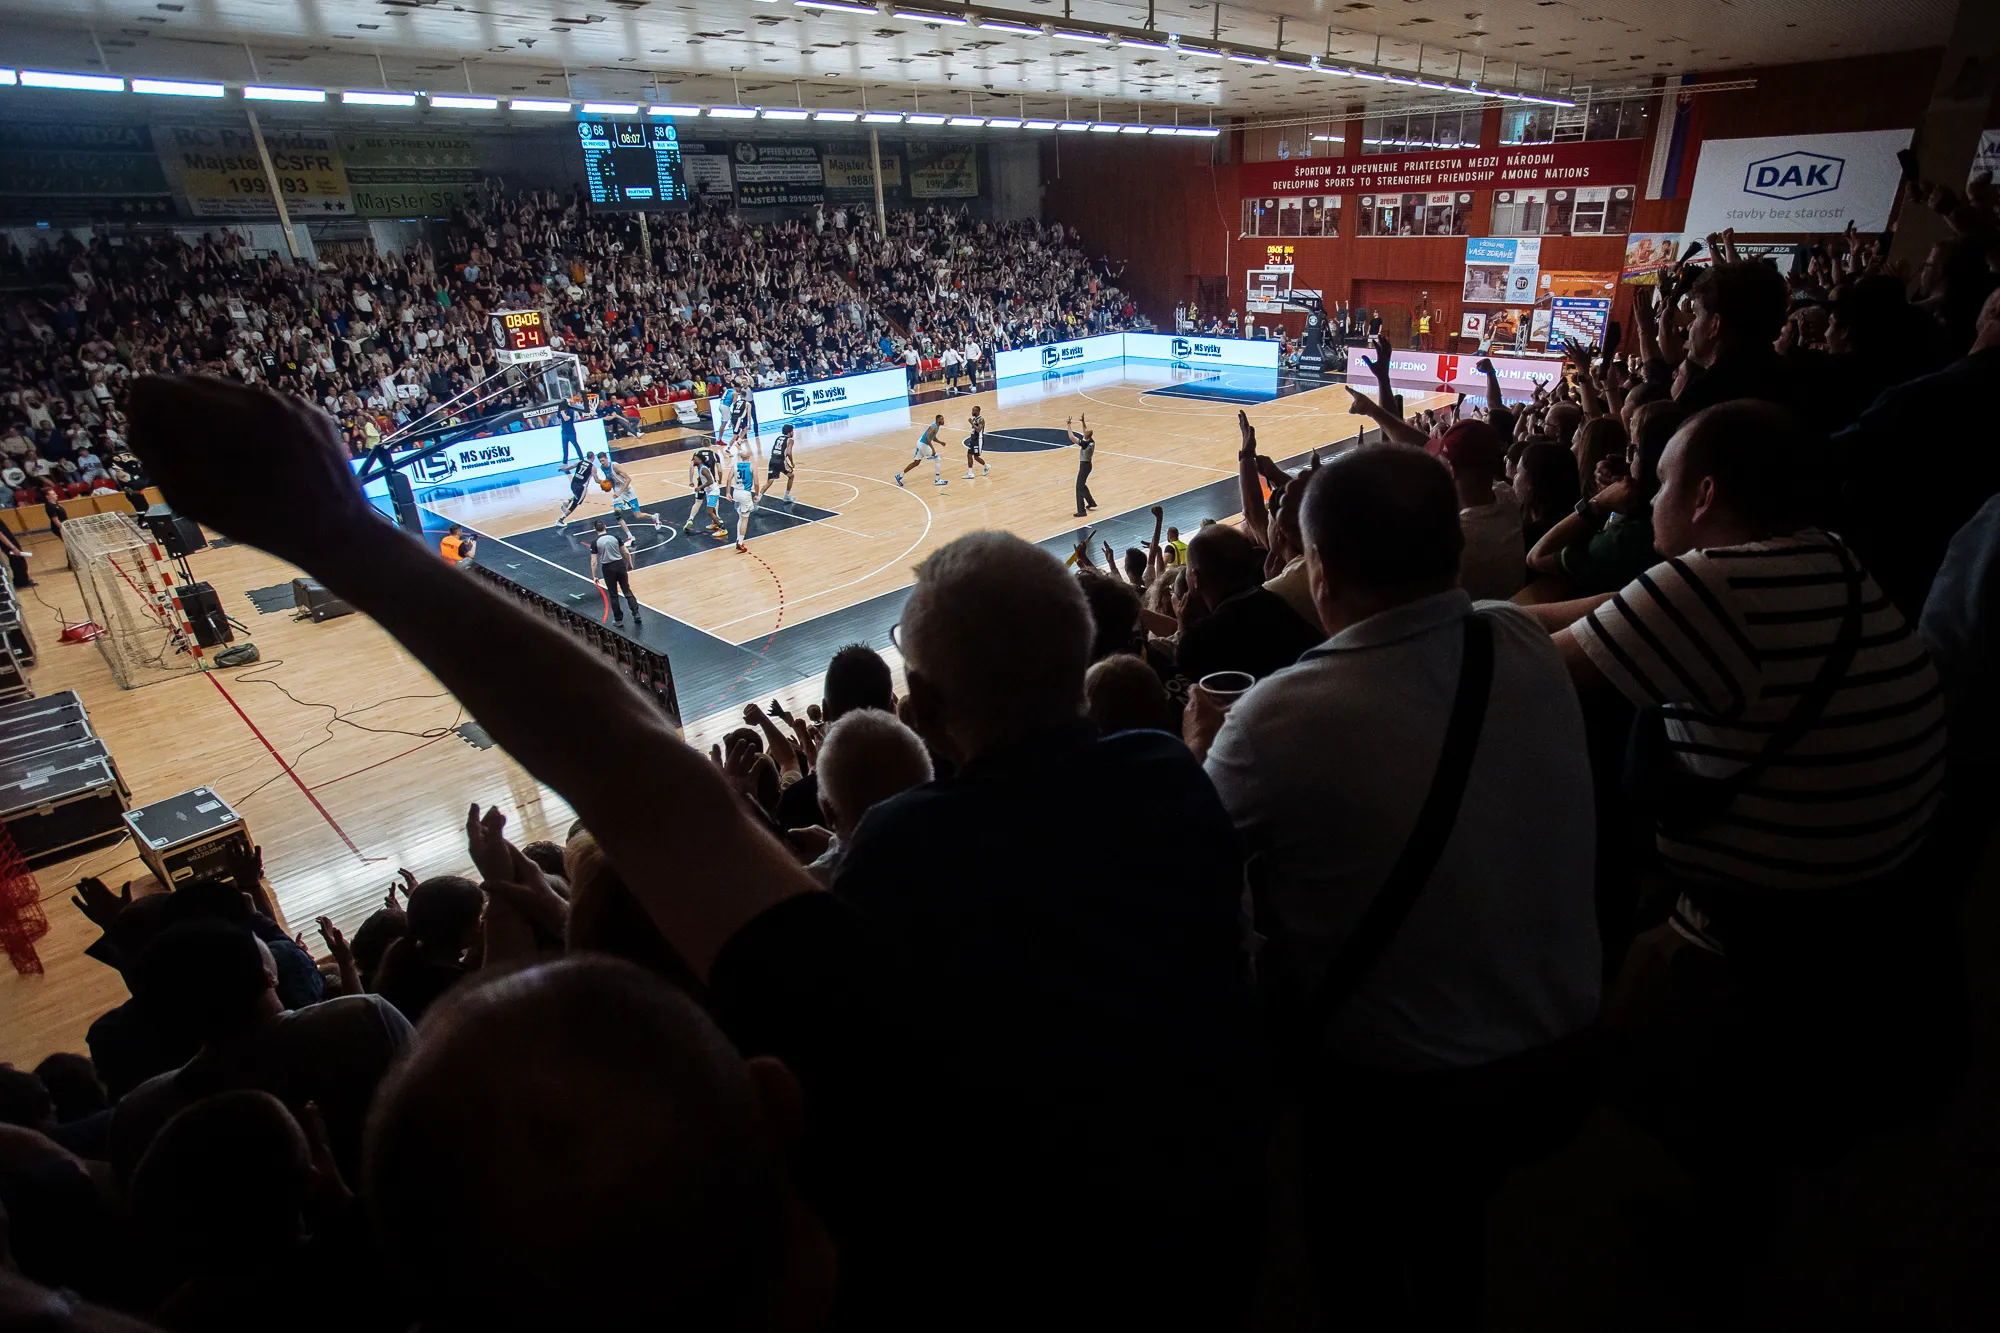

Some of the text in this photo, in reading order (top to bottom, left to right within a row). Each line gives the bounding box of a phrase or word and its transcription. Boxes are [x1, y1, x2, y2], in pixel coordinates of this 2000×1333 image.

[593, 125, 604, 136] 68
[654, 126, 664, 136] 58
[390, 140, 471, 148] PRIEVIDZA
[612, 140, 616, 148] 0
[620, 134, 640, 144] 08:07
[760, 148, 816, 156] PRIEVIDZA
[273, 151, 334, 172] ČSFR
[829, 159, 866, 172] Majster
[1294, 166, 1331, 177] ŠPORTOM
[1336, 166, 1346, 174] ZA
[1352, 163, 1398, 174] UPEVNENIE
[1468, 156, 1499, 168] MEDZI
[1506, 152, 1554, 166] NÁRODMI
[1273, 167, 1590, 190] DEVELOPING SPORTS TO STRENGTHEN FRIENDSHIP AMONG NATIONS
[1756, 164, 1832, 188] DAK
[228, 177, 309, 194] 199/93
[356, 192, 454, 212] Majster SR
[740, 196, 777, 204] MAJSTER
[1432, 194, 1450, 203] caffé
[1726, 208, 1766, 220] stavby
[1769, 208, 1791, 219] bez
[1468, 246, 1485, 256] VAŠE
[1268, 256, 1280, 264] 24
[1284, 256, 1292, 264] 24
[506, 313, 540, 328] 08:06
[516, 332, 539, 348] 24
[1062, 348, 1069, 356] MS
[1204, 344, 1220, 353] výšky
[1390, 361, 1398, 370] MI
[1399, 362, 1427, 372] JEDNO
[1510, 370, 1520, 379] MI
[1522, 372, 1554, 381] JEDNO
[813, 387, 845, 400] MS výšky
[523, 405, 559, 418] SPORT SYSTEM
[460, 446, 510, 464] MS výšky
[578, 465, 588, 474] 17
[737, 470, 746, 480] 31
